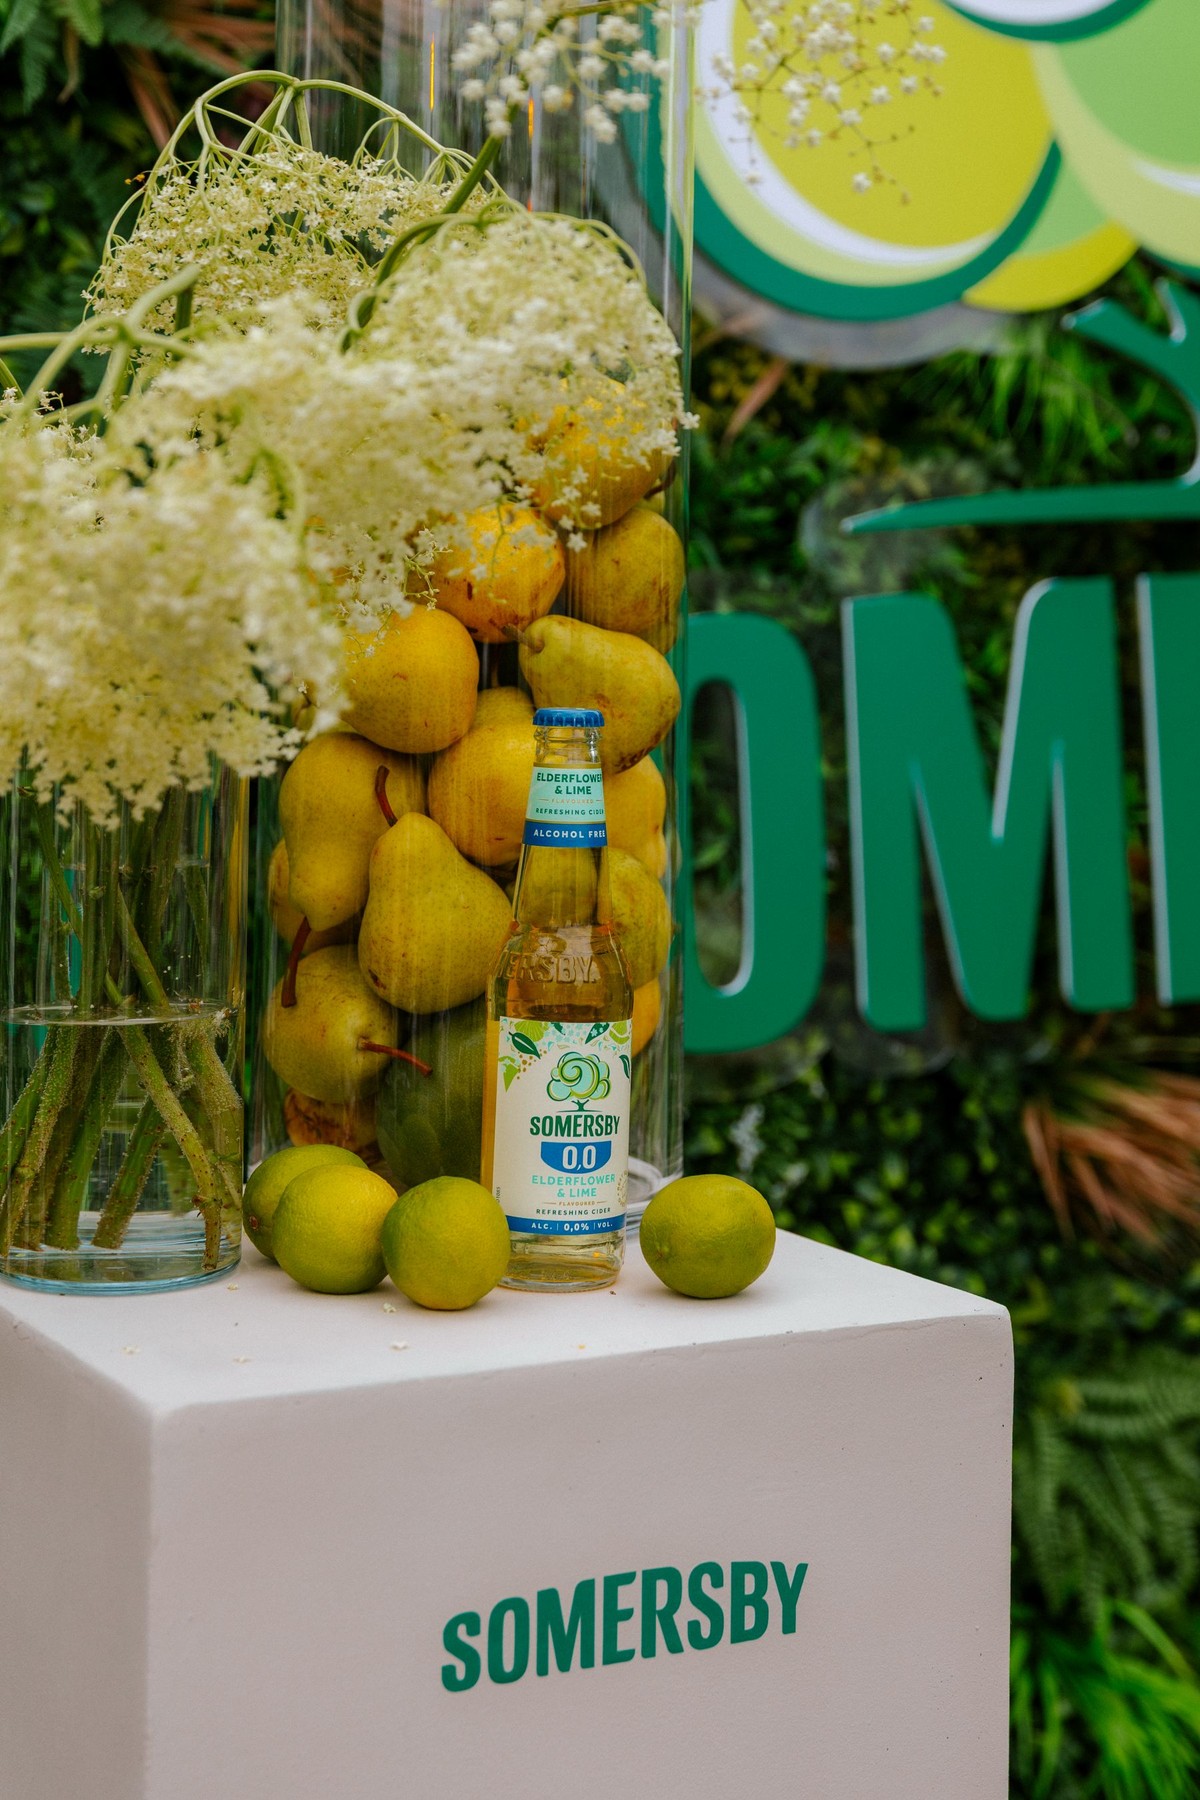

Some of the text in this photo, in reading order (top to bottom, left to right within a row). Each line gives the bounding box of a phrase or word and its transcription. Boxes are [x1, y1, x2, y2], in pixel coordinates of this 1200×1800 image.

[554, 786, 592, 795] & LIME
[535, 807, 586, 816] REFRESHING
[533, 830, 606, 838] ALCOHOL FREE
[529, 1114, 620, 1137] SOMERSBY
[562, 1145, 597, 1171] 0,0
[531, 1174, 616, 1186] ELDERFLOWER
[557, 1187, 597, 1198] & LIME
[536, 1207, 611, 1216] REFRESHING CIDER
[563, 1223, 590, 1232] 0,0%
[441, 1561, 809, 1692] SOMERSBY
